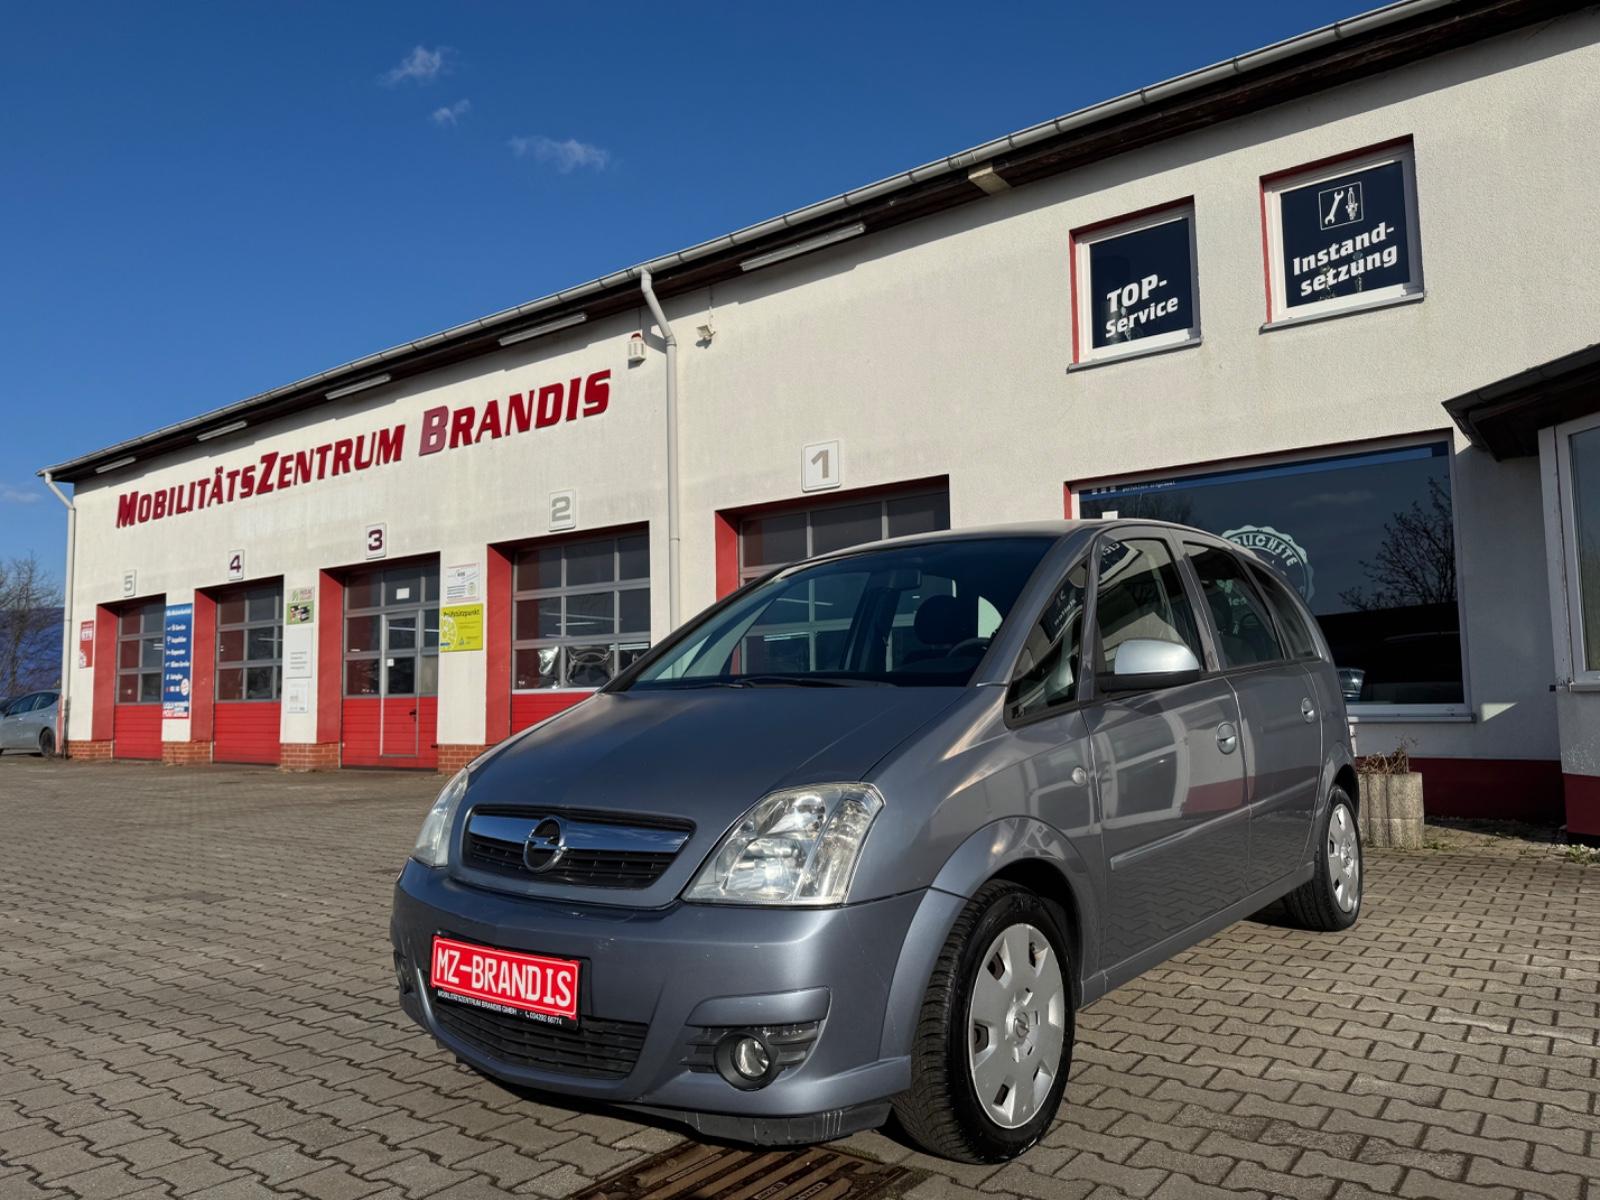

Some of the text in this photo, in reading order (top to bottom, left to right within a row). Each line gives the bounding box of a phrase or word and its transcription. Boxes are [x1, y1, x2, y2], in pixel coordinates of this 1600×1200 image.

[1292, 221, 1395, 276] Instand-
[1300, 245, 1399, 297] setzung
[1106, 273, 1168, 313] TOP-
[418, 369, 612, 456] BRANDIS
[810, 449, 829, 479] 1
[551, 496, 571, 522] 2
[367, 528, 384, 551] 3
[229, 554, 242, 574] 4
[123, 574, 134, 592] 5
[436, 947, 571, 1007] MZ-BRANDIS
[481, 1001, 502, 1012] BRANDIS
